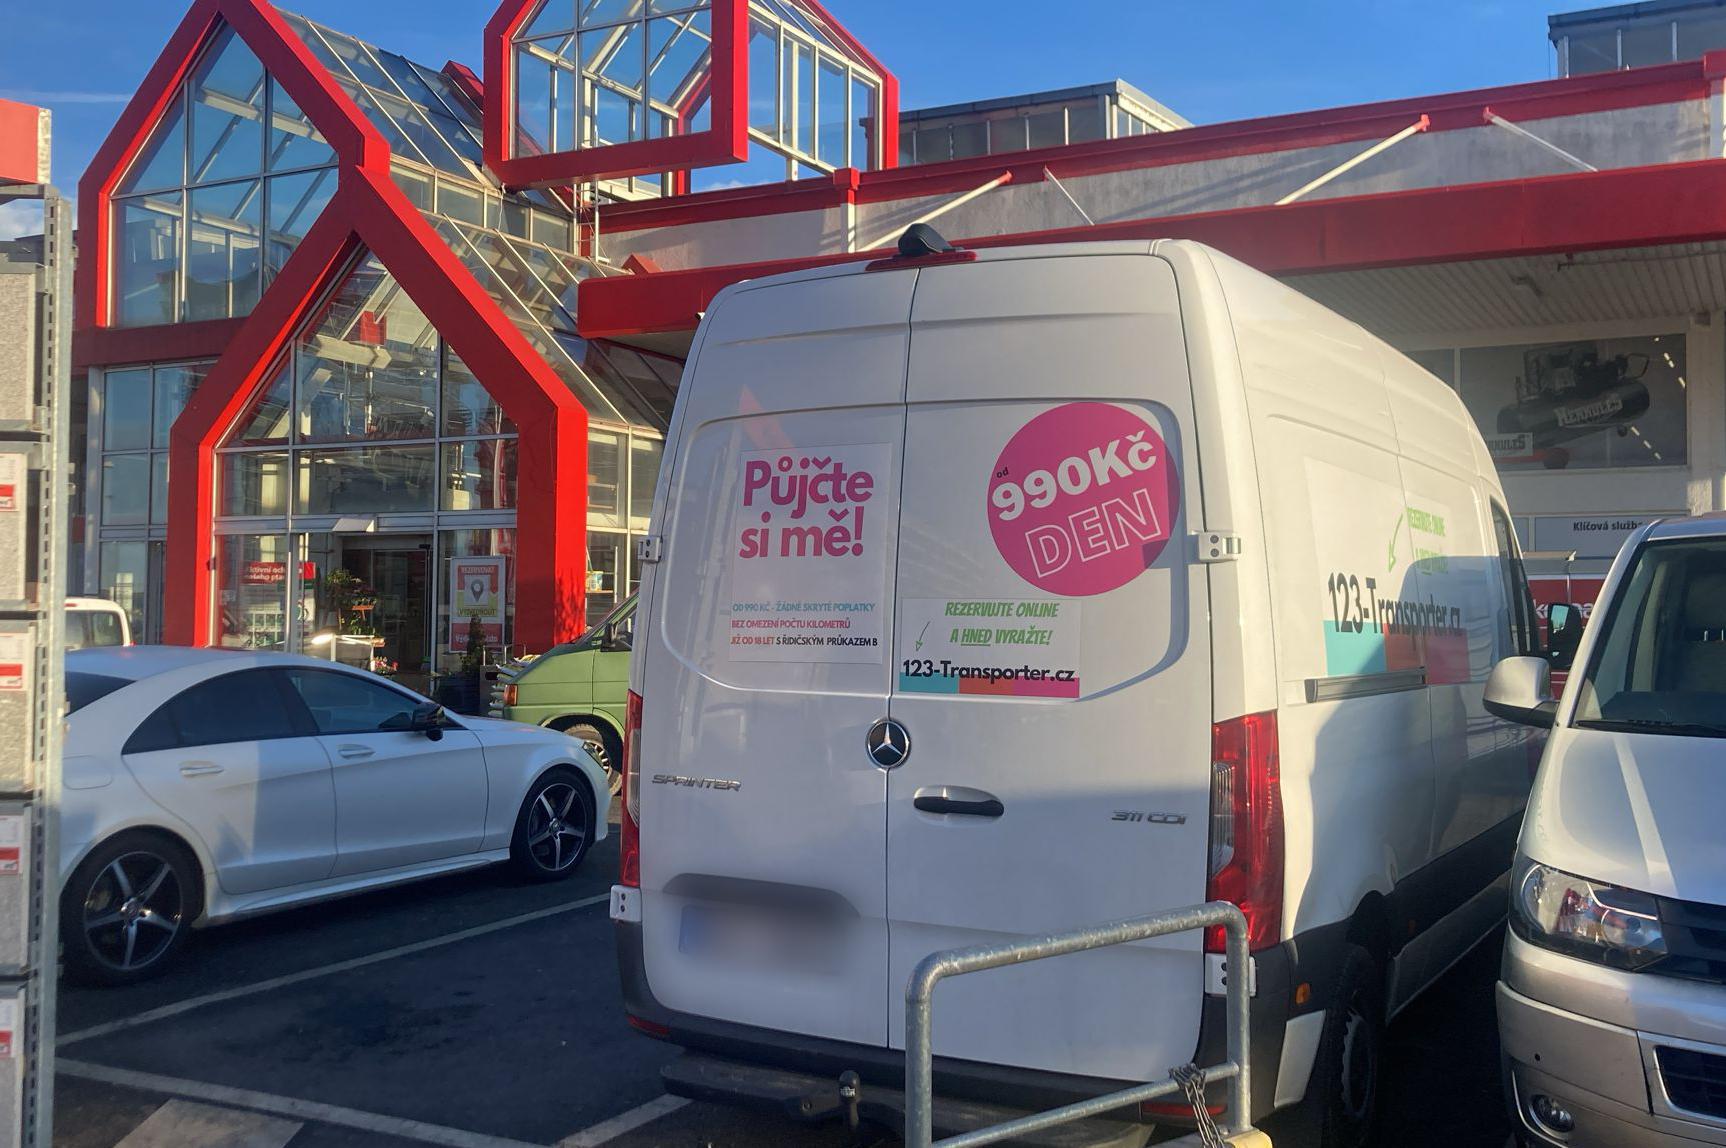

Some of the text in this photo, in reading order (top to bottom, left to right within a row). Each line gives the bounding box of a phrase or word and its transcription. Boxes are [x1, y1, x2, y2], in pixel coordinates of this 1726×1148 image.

[992, 431, 1157, 521] 990Kč
[996, 467, 1009, 479] od
[743, 456, 874, 519] Půjčte
[739, 506, 864, 558] si mě!
[1025, 488, 1162, 578] DEN
[1611, 520, 1642, 531] služb
[833, 603, 875, 612] POPLATKY
[945, 602, 1060, 618] REZERVUJTE ONLINE
[731, 617, 851, 629] BEZ OMEZENÍ POČTU KILOMETRŮ
[743, 636, 753, 645] OD
[763, 637, 774, 646] LET
[782, 634, 824, 646] ŘIDIČSKÝM
[827, 634, 871, 647] PRŮKAZEM
[950, 625, 1054, 646] A HNED VYRAŽTE!
[903, 659, 1076, 685] 123-Transporter.cz
[652, 774, 742, 792] SPRINTER
[1111, 810, 1145, 822] 311
